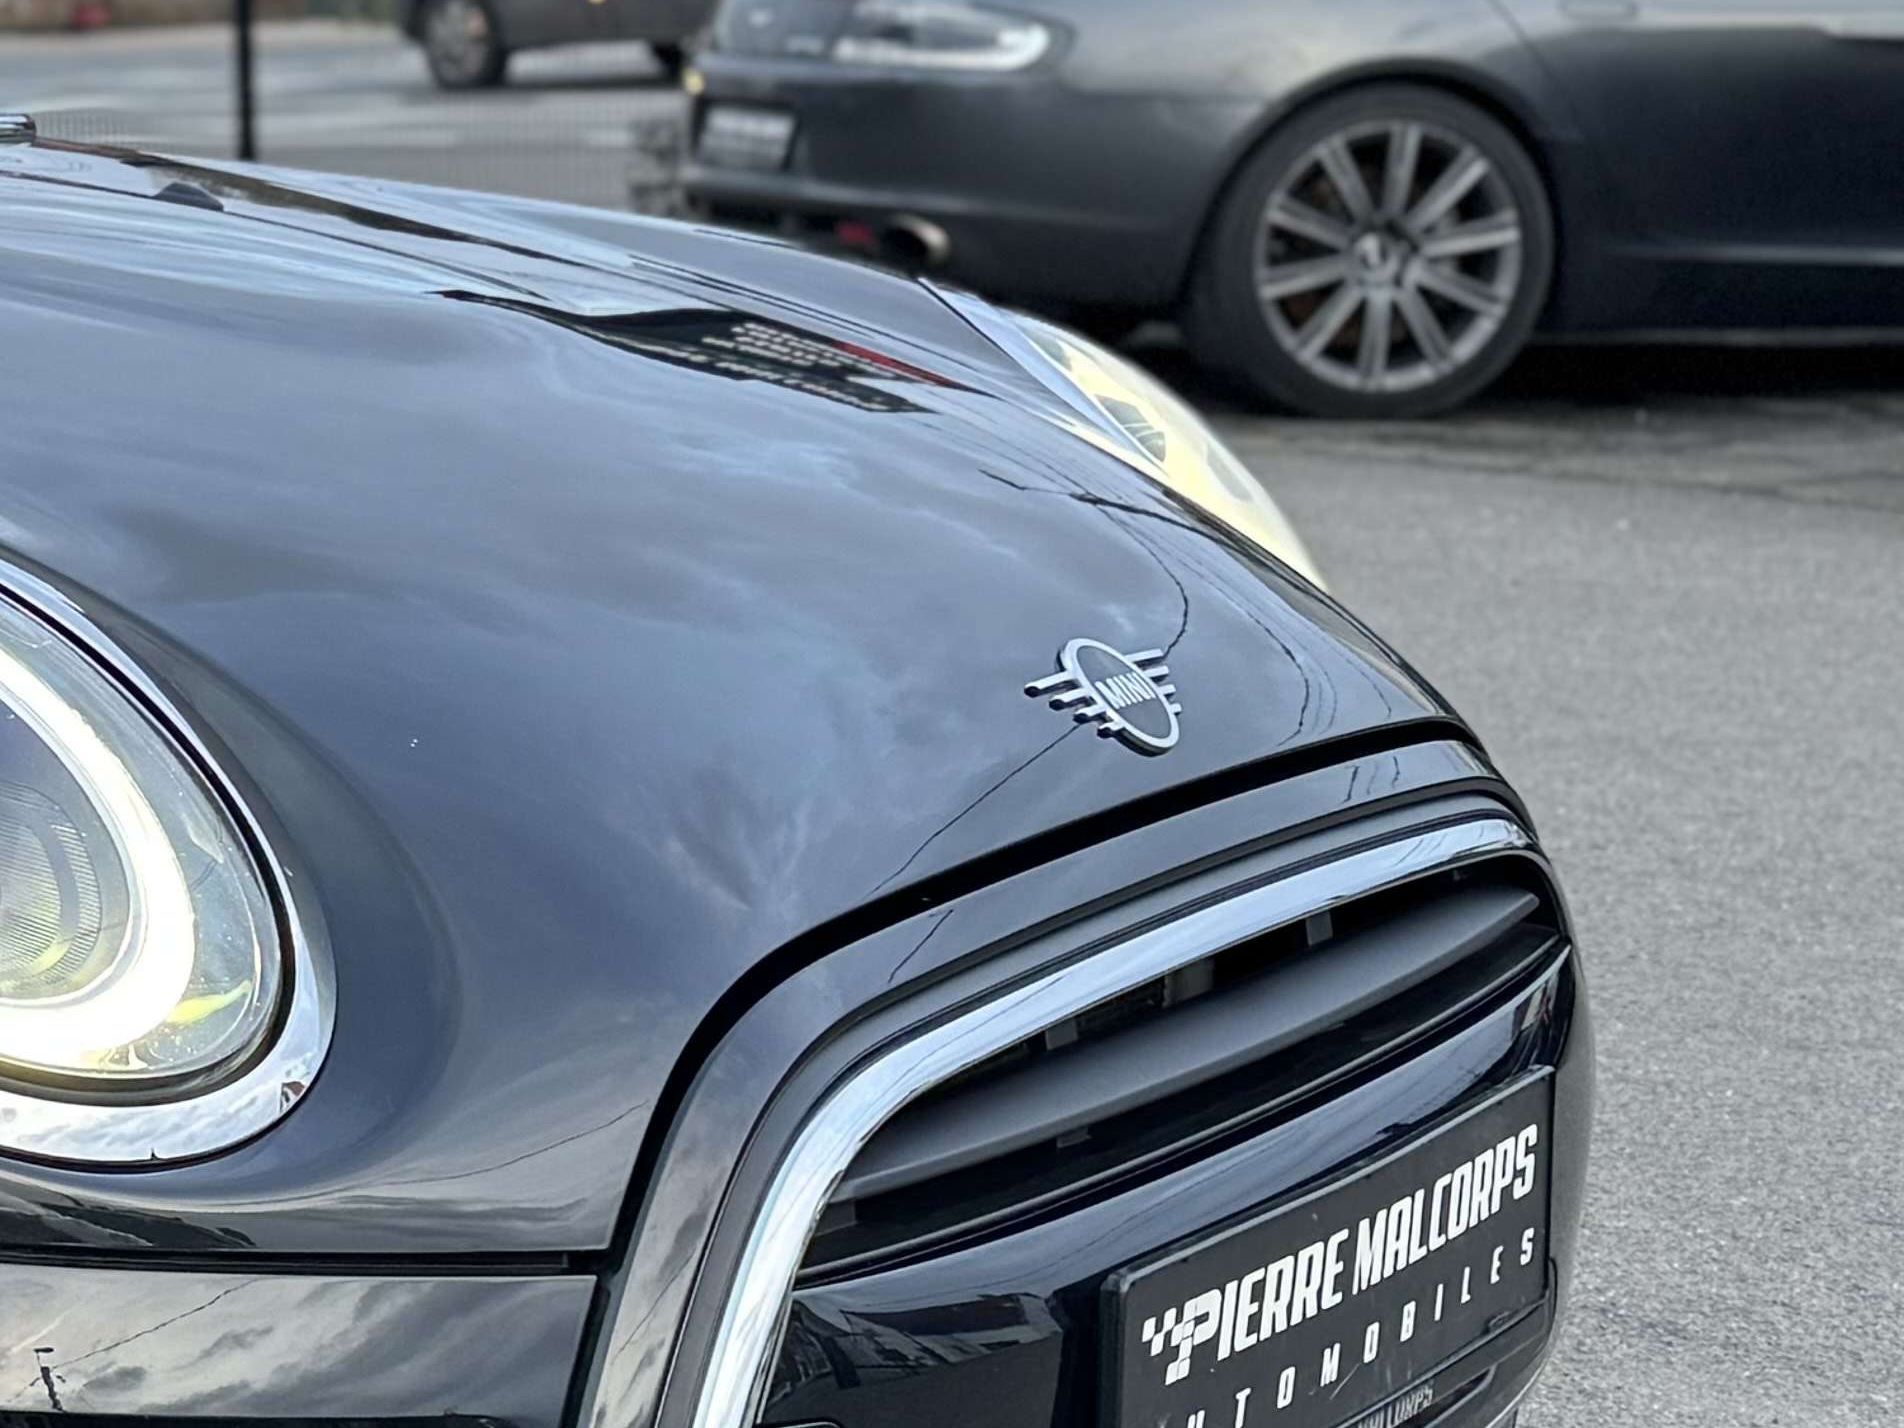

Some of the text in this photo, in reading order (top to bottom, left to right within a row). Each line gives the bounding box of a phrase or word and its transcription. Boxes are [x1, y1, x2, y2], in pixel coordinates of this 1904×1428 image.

[1094, 670, 1156, 711] MINI
[1160, 1124, 1538, 1386] PIERRE MALCORPS
